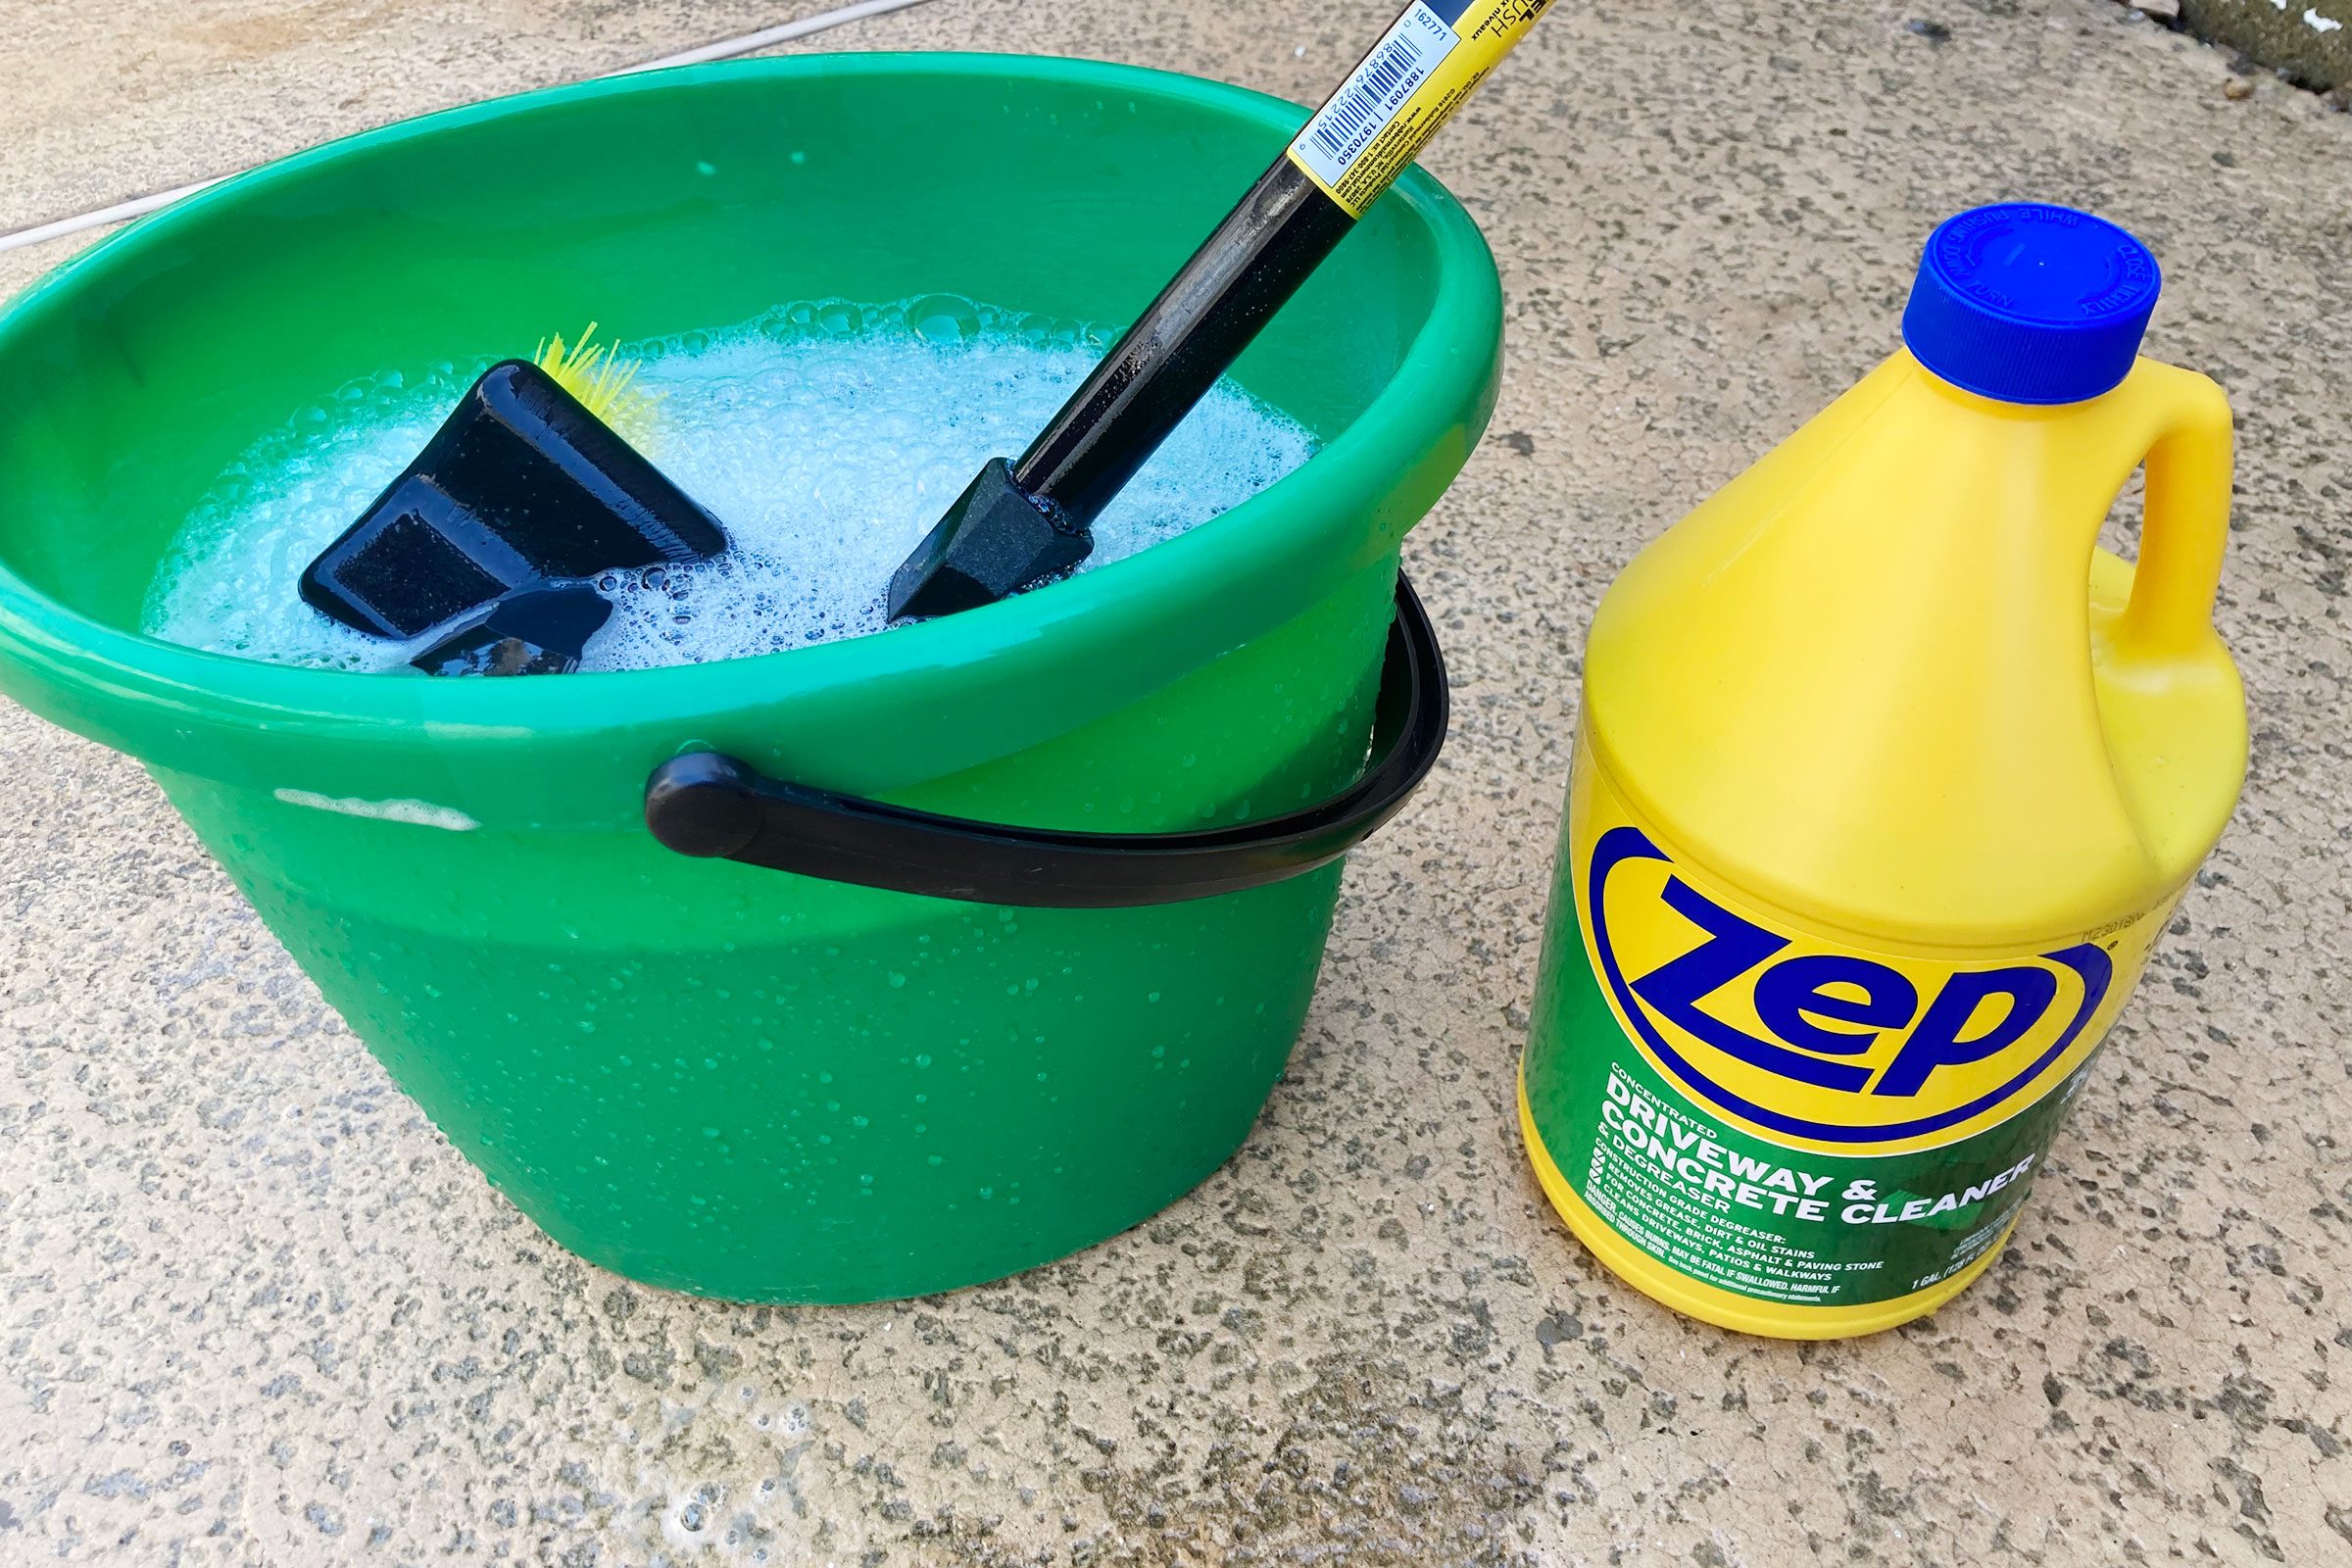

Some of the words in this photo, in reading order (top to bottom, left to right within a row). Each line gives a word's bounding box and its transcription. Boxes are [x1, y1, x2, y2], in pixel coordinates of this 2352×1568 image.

[1412, 9, 1448, 42] 162771
[1471, 8, 1501, 41] niveaux
[1492, 0, 1529, 38] USH
[1355, 43, 1393, 84] 86876
[1317, 89, 1353, 128] 22215
[1384, 66, 1425, 111] 1887091
[1337, 122, 1376, 165] 1970350
[1379, 122, 1399, 144] Contact
[1408, 107, 1439, 140] Rubbermaid
[1336, 152, 1373, 194] 1-800-347-9800
[1341, 107, 1421, 198] www.rubbermaidcommercial.com
[1375, 161, 1383, 170] NC
[1381, 140, 1409, 173] Commercial
[1351, 197, 1360, 207] LLC
[1359, 172, 1382, 197] Products
[1946, 209, 2008, 244] PUSHING
[2018, 208, 2080, 226] WHILE
[1968, 281, 2014, 308] TURN
[1612, 1062, 1717, 1138] CONCENTRATED
[1606, 1072, 1835, 1196] DRIVEWAY
[1841, 1180, 1878, 1200] &
[1598, 1121, 1608, 1139] &
[1612, 1134, 1731, 1213] DEGREASER
[1602, 1100, 1830, 1222] CONCRETE
[1840, 1153, 2035, 1224] CLEANER
[1595, 1137, 1667, 1198] CONSTRUCTION
[1670, 1196, 1707, 1219] GRADE
[1710, 1215, 1787, 1245] DEGREASER:
[1608, 1162, 1652, 1201] REMOVES
[1655, 1199, 1700, 1229] GREASE,
[1705, 1225, 1733, 1240] DIRT
[1747, 1240, 1766, 1251] OIL
[1772, 1246, 1815, 1258] STAINS
[1603, 1184, 1640, 1216] CLEANS
[1642, 1214, 1705, 1253] DRIVEWAYS,
[1709, 1249, 1749, 1268] PATIOS
[1766, 1266, 1832, 1281] WALKWAYS
[1605, 1173, 1624, 1193] FOR
[1626, 1190, 1682, 1231] CONCRETE,
[1686, 1225, 1724, 1250] BRICK,
[1727, 1246, 1782, 1264] ASPHALT
[1796, 1261, 1841, 1270] PAVING
[1844, 1261, 1884, 1270] STONE
[1585, 1191, 1615, 1223] ABSORBED
[1616, 1218, 1646, 1246] THROUGH
[1646, 1242, 1666, 1258] SKIN.
[1668, 1256, 1679, 1265] See
[1679, 1261, 1692, 1271] back
[1692, 1269, 1708, 1280] panel
[1718, 1277, 1747, 1292] additional
[1747, 1287, 1788, 1299] precautionary
[1619, 1211, 1644, 1234] CAUSES
[1645, 1230, 1670, 1251] BURNS.
[1672, 1246, 1690, 1259] MAY
[1690, 1255, 1701, 1264] BE
[1701, 1260, 1725, 1275] FATAL
[1727, 1269, 1735, 1278] IF
[1736, 1272, 1788, 1291] SWALLOWED.
[1790, 1283, 1830, 1294] HARMFUL
[1912, 1280, 1919, 1290] 1
